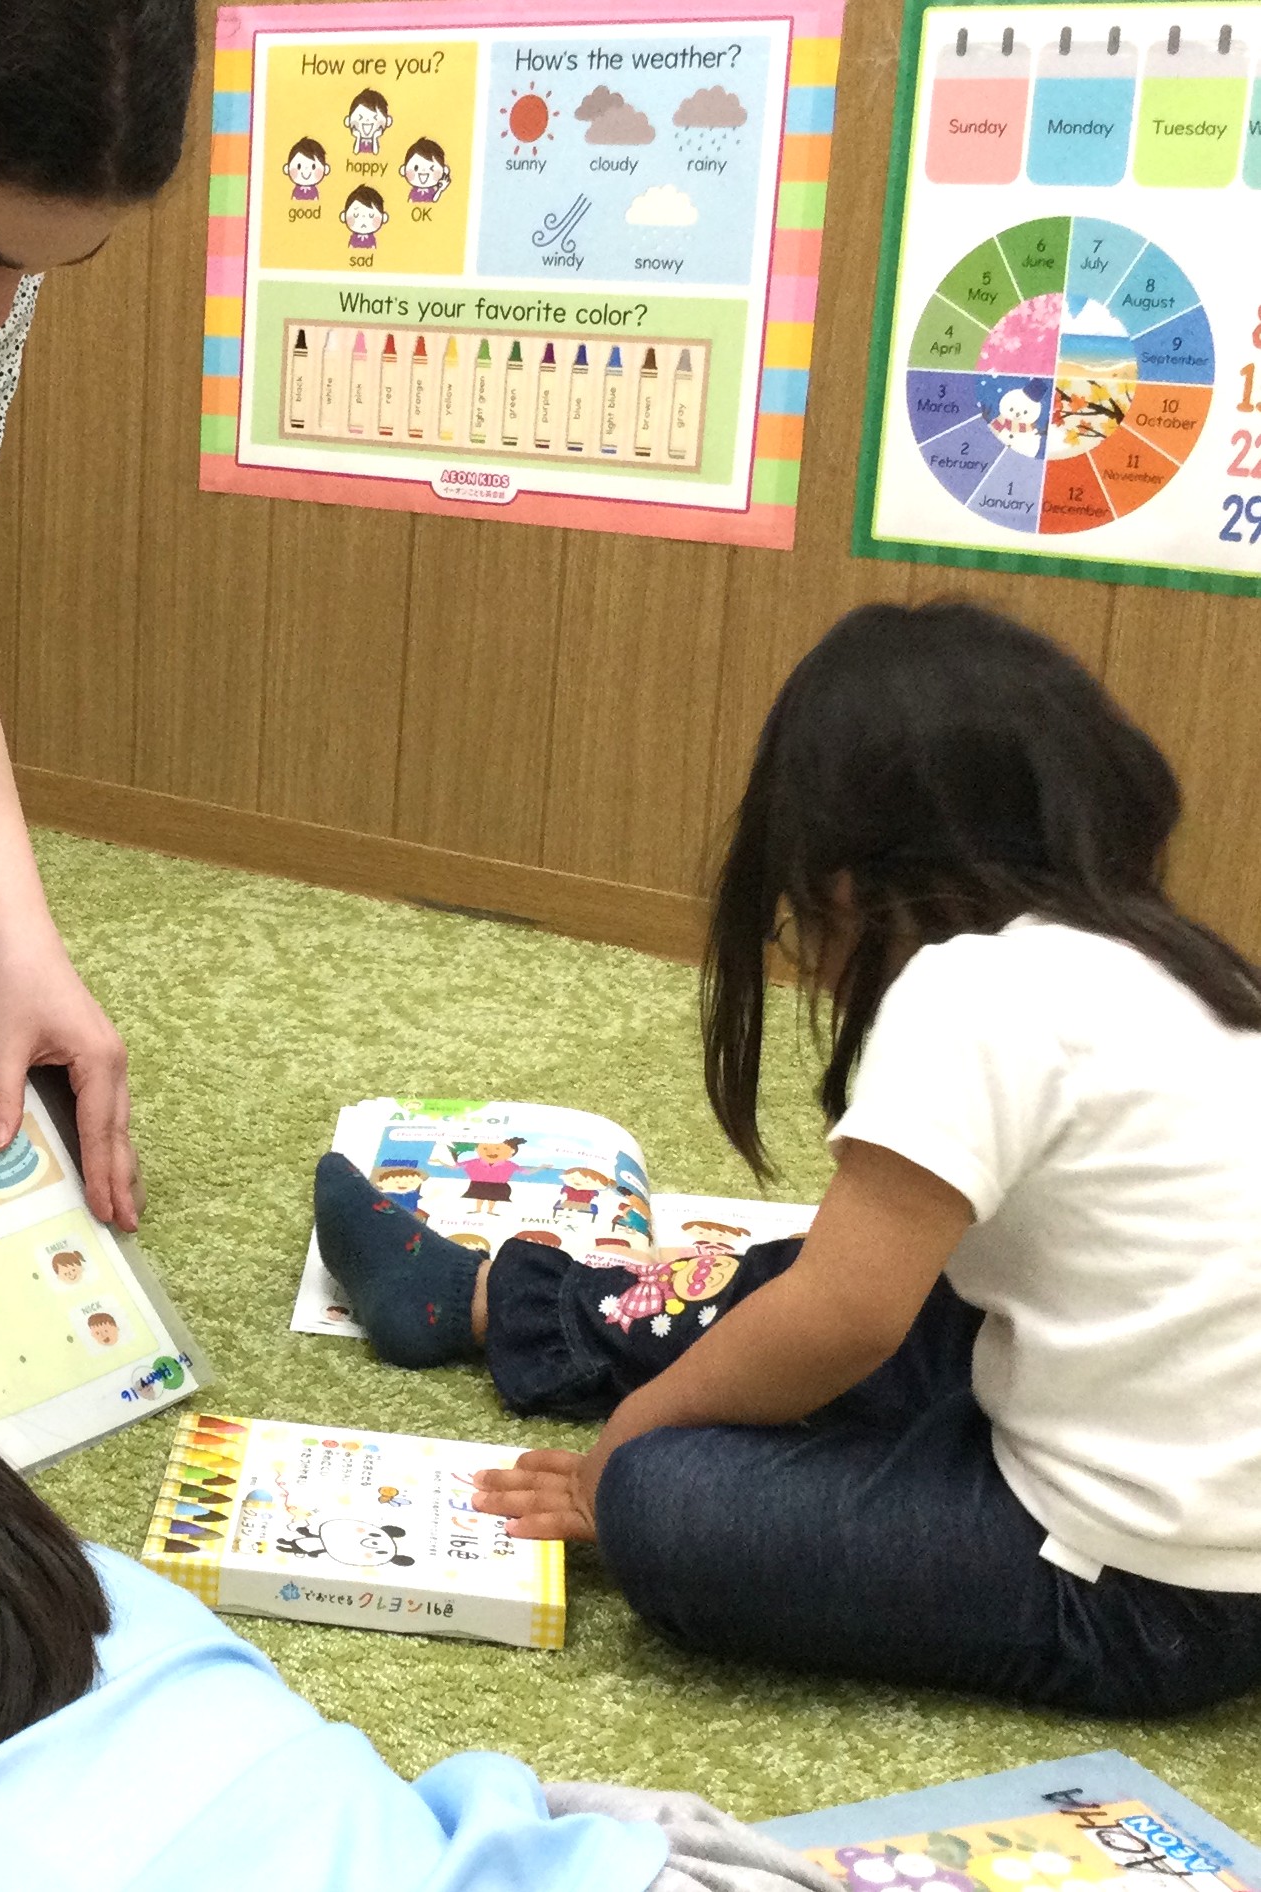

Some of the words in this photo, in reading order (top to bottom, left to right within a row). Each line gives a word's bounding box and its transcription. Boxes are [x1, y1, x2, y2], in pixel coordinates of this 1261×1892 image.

[301, 54, 345, 75] How
[352, 57, 387, 75] are
[395, 51, 445, 81] you?
[515, 48, 578, 71] How's
[588, 47, 623, 70] the
[632, 44, 742, 70] weather?
[948, 119, 1008, 137] Sunday
[1047, 119, 1114, 138] Monday
[1152, 119, 1228, 140] Tuesday
[346, 159, 388, 177] happy
[505, 158, 547, 174] sunny
[589, 156, 639, 175] cloudy
[687, 156, 727, 175] rainy
[288, 206, 322, 222] good
[411, 207, 433, 222] OK
[1036, 239, 1046, 253] 6
[1093, 240, 1103, 254] 7
[349, 254, 373, 267] sad
[542, 252, 585, 271] windy
[634, 257, 684, 274] snowy
[1021, 255, 1055, 270] June
[1080, 257, 1109, 273] July
[982, 271, 992, 286] 5
[1145, 278, 1156, 293] 8
[968, 288, 998, 304] May
[1122, 295, 1175, 310] August
[339, 292, 410, 316] What's
[418, 298, 466, 323] your
[474, 297, 567, 324] favorite
[575, 303, 648, 327] color?
[945, 325, 954, 339] 4
[929, 341, 961, 356] April
[1172, 337, 1182, 352] 9
[1141, 352, 1210, 368] September
[296, 376, 304, 402] black
[355, 383, 363, 404] pink
[414, 379, 425, 415] orange
[478, 376, 486, 404] green
[938, 383, 947, 398] 3
[445, 383, 453, 416] yellow
[509, 389, 517, 419] green
[542, 389, 550, 423] purple
[609, 387, 617, 409] blue
[917, 399, 960, 414] March
[1162, 399, 1179, 414] 10
[573, 397, 582, 419] blue
[642, 396, 652, 430] brown
[675, 403, 686, 429] gray
[606, 412, 615, 435] light
[1135, 414, 1197, 430] October
[961, 442, 969, 456] 2
[929, 455, 989, 473] February
[1126, 454, 1140, 468] 11
[440, 469, 476, 486] AEON
[478, 473, 510, 488] KIDS
[1103, 469, 1164, 485] November
[1006, 482, 1014, 496] 1
[1068, 487, 1084, 502] 12
[979, 493, 1034, 514] January
[1042, 500, 1111, 518] December
[521, 1216, 560, 1225] EMILY
[81, 1301, 103, 1315] NICK
[1124, 1815, 1220, 1874] AEON
